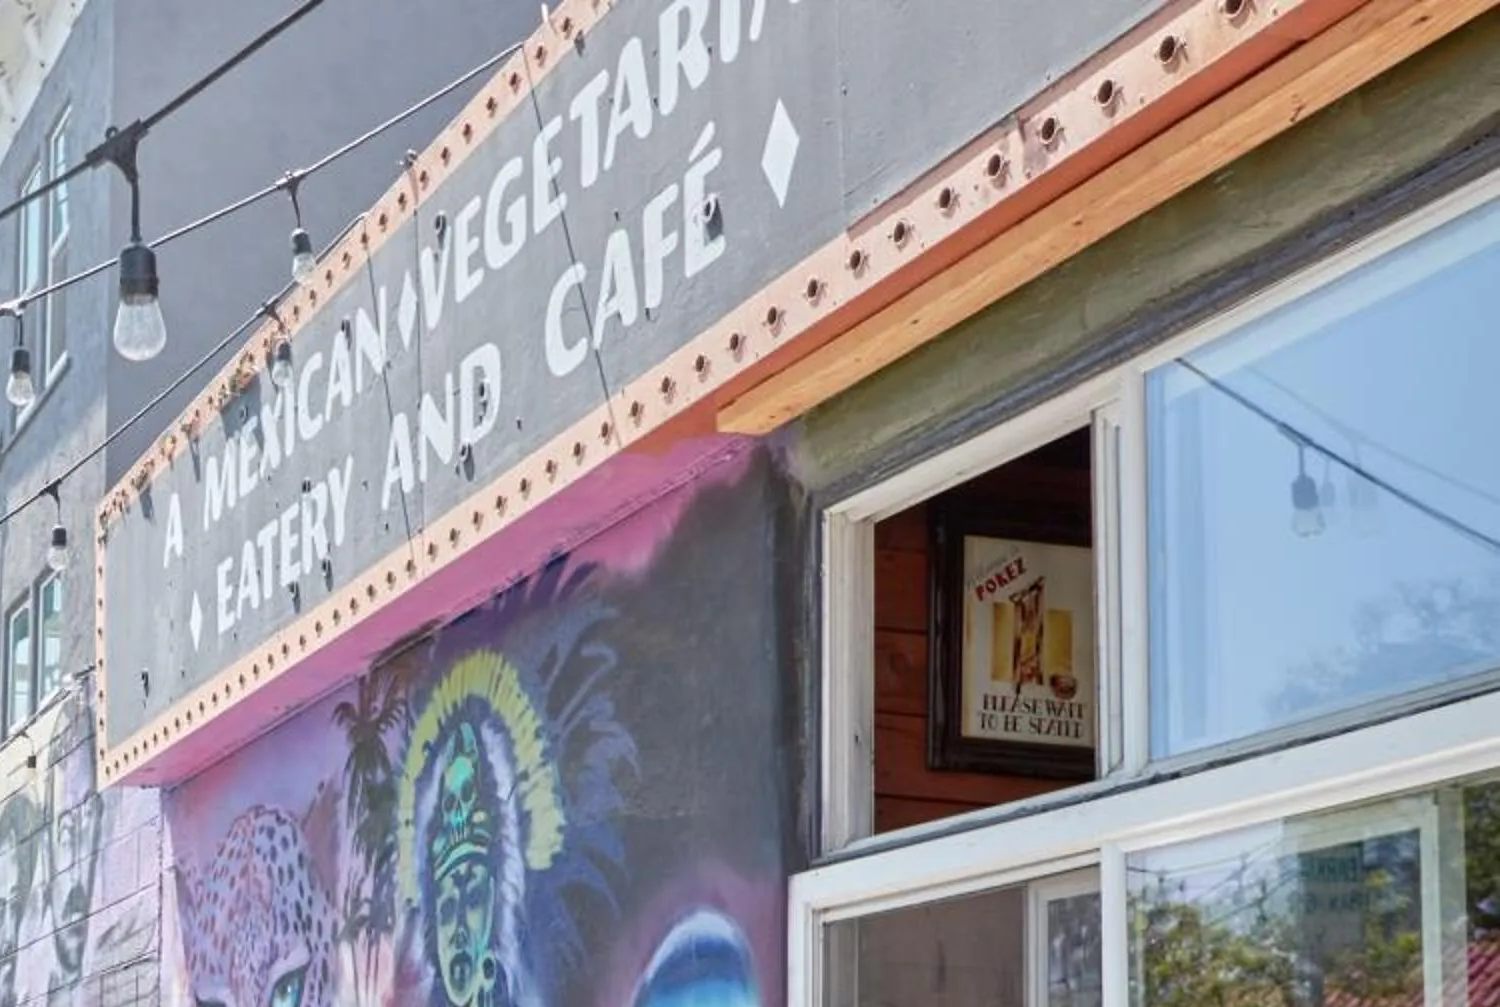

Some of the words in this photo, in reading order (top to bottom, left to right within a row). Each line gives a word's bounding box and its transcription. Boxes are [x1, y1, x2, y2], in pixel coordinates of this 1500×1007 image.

[164, 492, 183, 568] A
[203, 285, 388, 531] MEXICAN
[216, 455, 354, 635] EATERY
[381, 342, 501, 511] AND
[545, 120, 727, 377] CAFÉ
